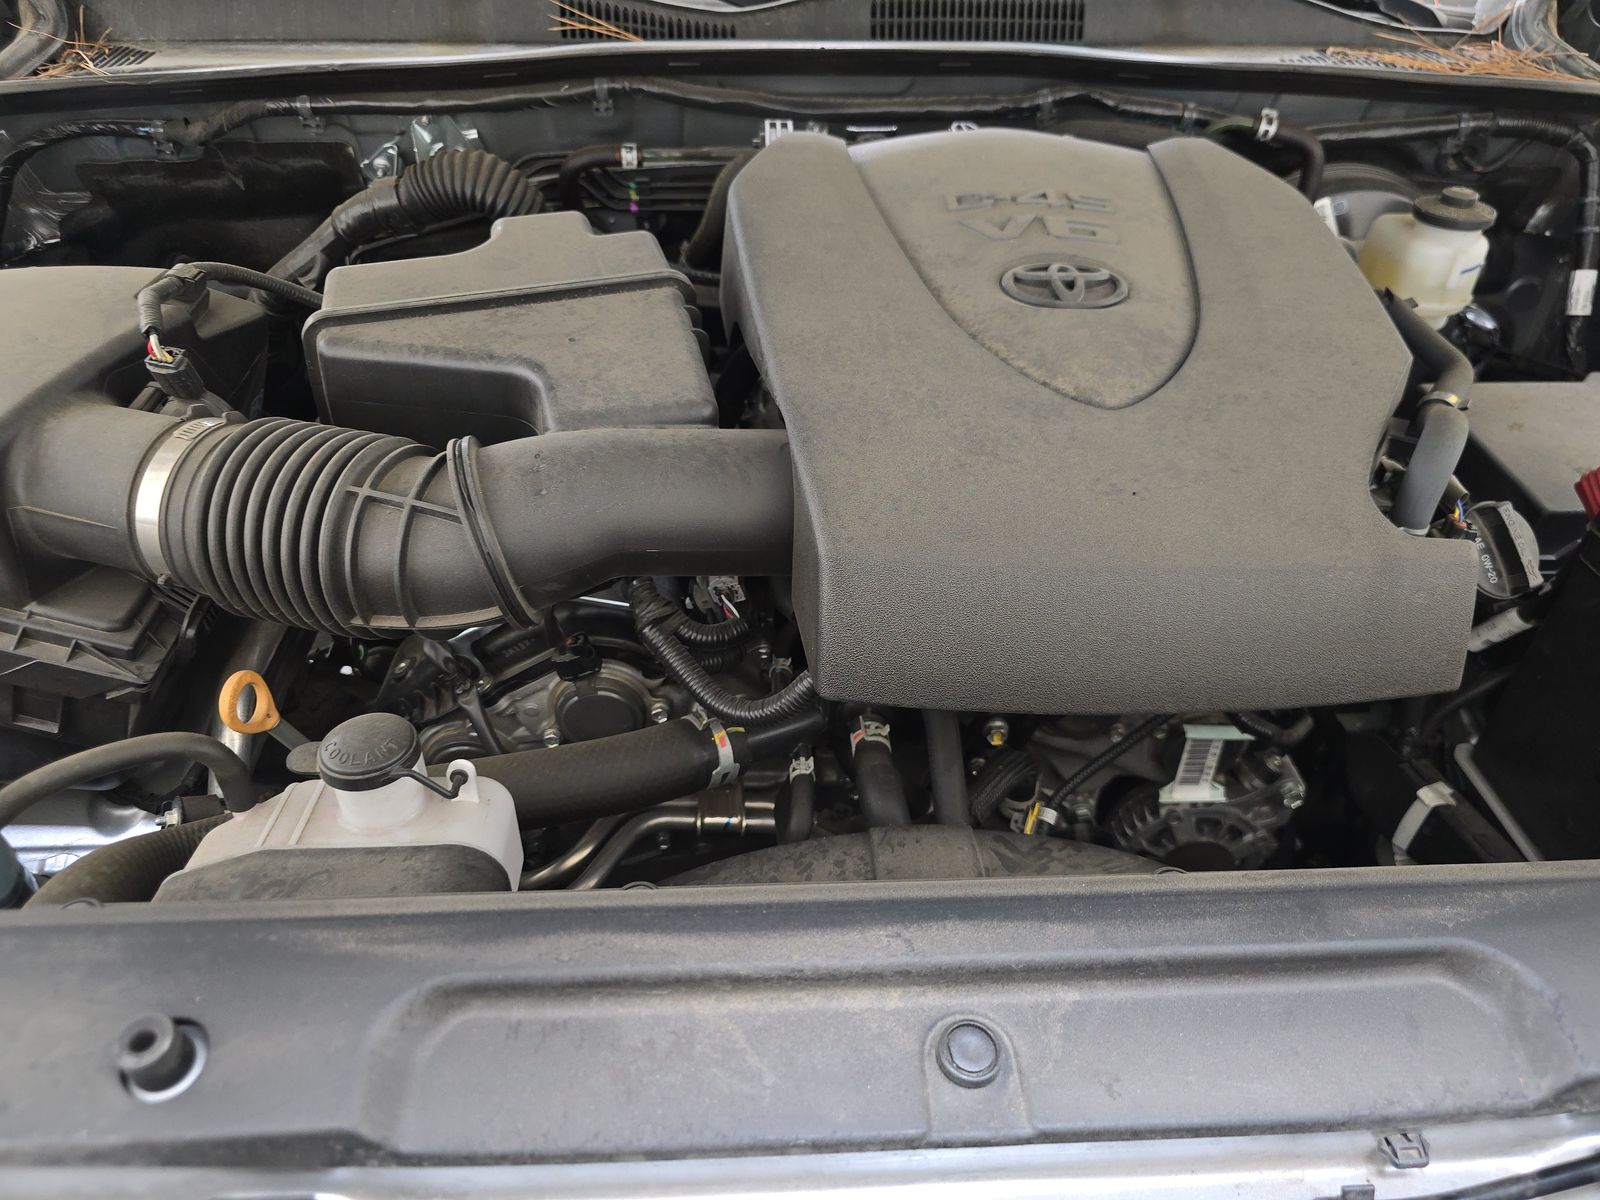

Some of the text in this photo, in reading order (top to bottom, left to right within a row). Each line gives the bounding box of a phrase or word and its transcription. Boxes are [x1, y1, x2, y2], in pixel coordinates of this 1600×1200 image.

[950, 216, 1120, 244] V6
[1503, 506, 1521, 541] ENGINE
[1480, 554, 1498, 583] 0W-20
[324, 738, 398, 765] COOLANT
